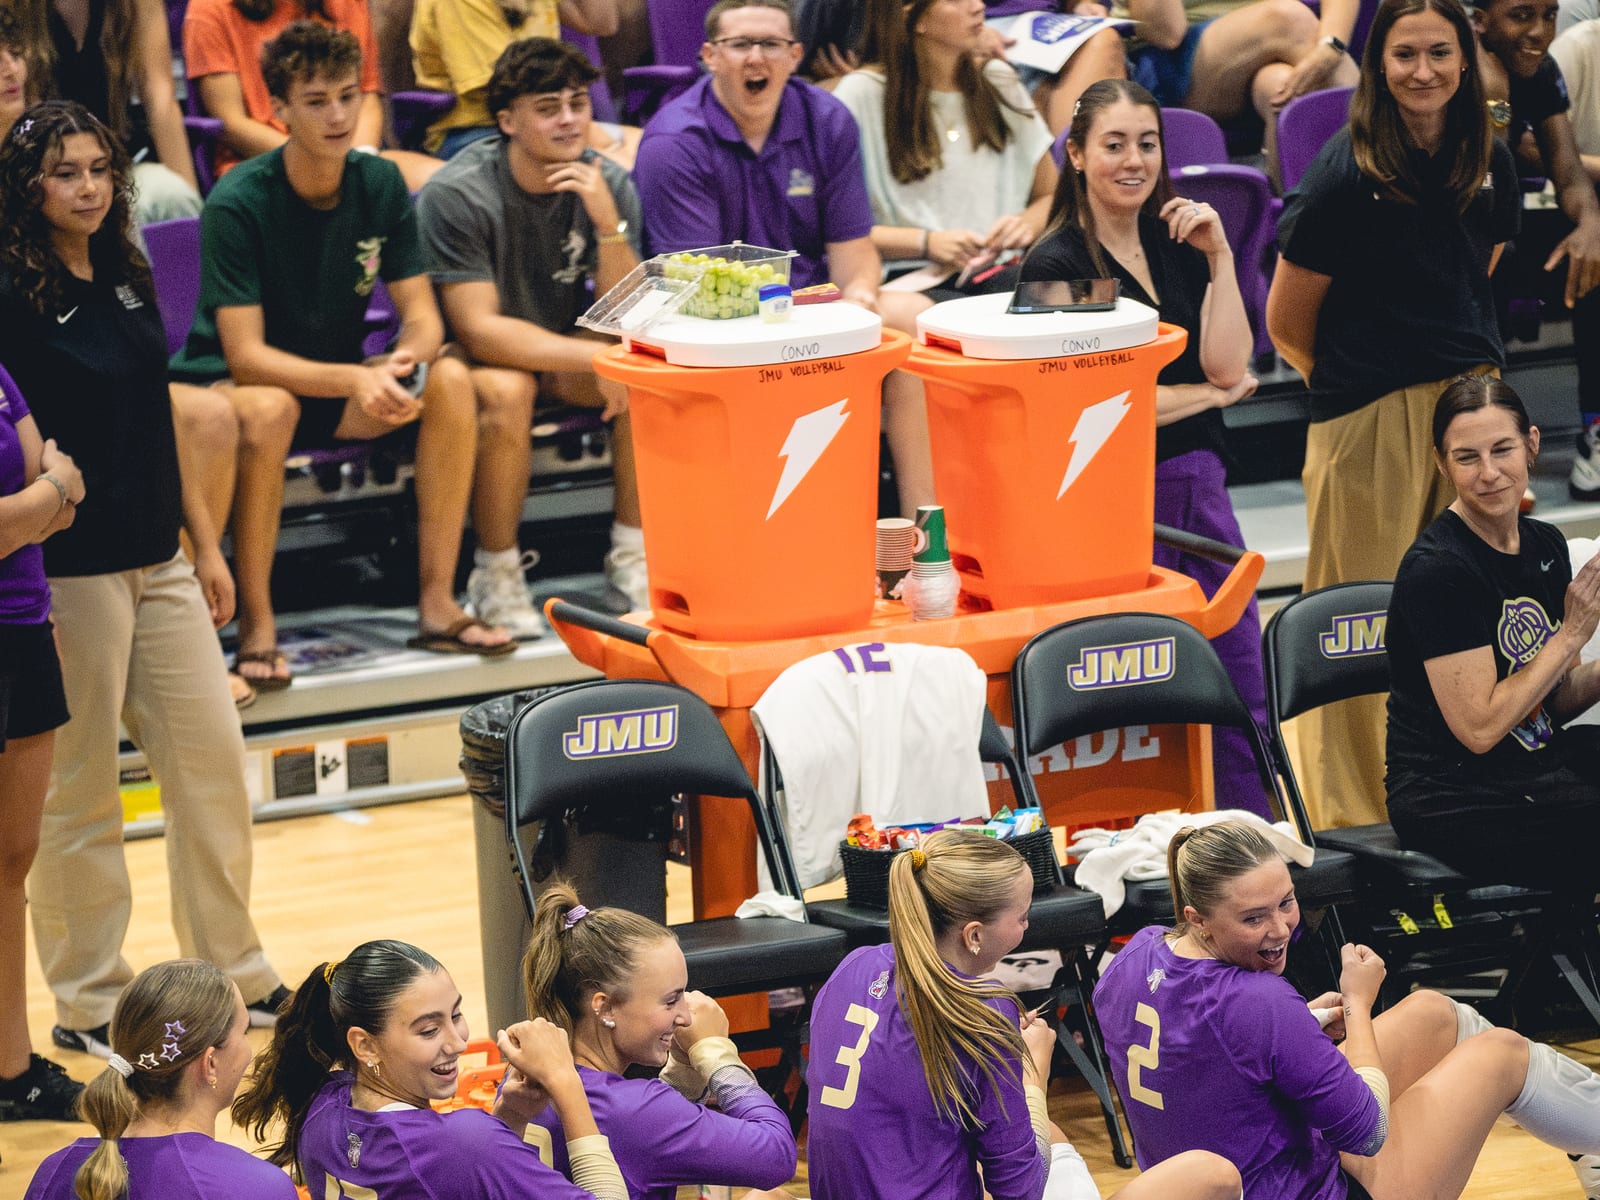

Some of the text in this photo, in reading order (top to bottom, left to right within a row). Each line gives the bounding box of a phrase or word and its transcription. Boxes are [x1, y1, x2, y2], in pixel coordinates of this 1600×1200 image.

[781, 342, 820, 361] CONVO
[1038, 352, 1135, 374] JMU VOLLEYBALL
[1061, 336, 1101, 354] CONVO
[758, 360, 846, 384] JMU VOLLEYBALL
[1323, 615, 1387, 654] JM
[1071, 641, 1172, 687] JMU
[567, 709, 675, 756] JMU
[819, 1002, 880, 1110] 3
[1126, 1001, 1165, 1111] 2
